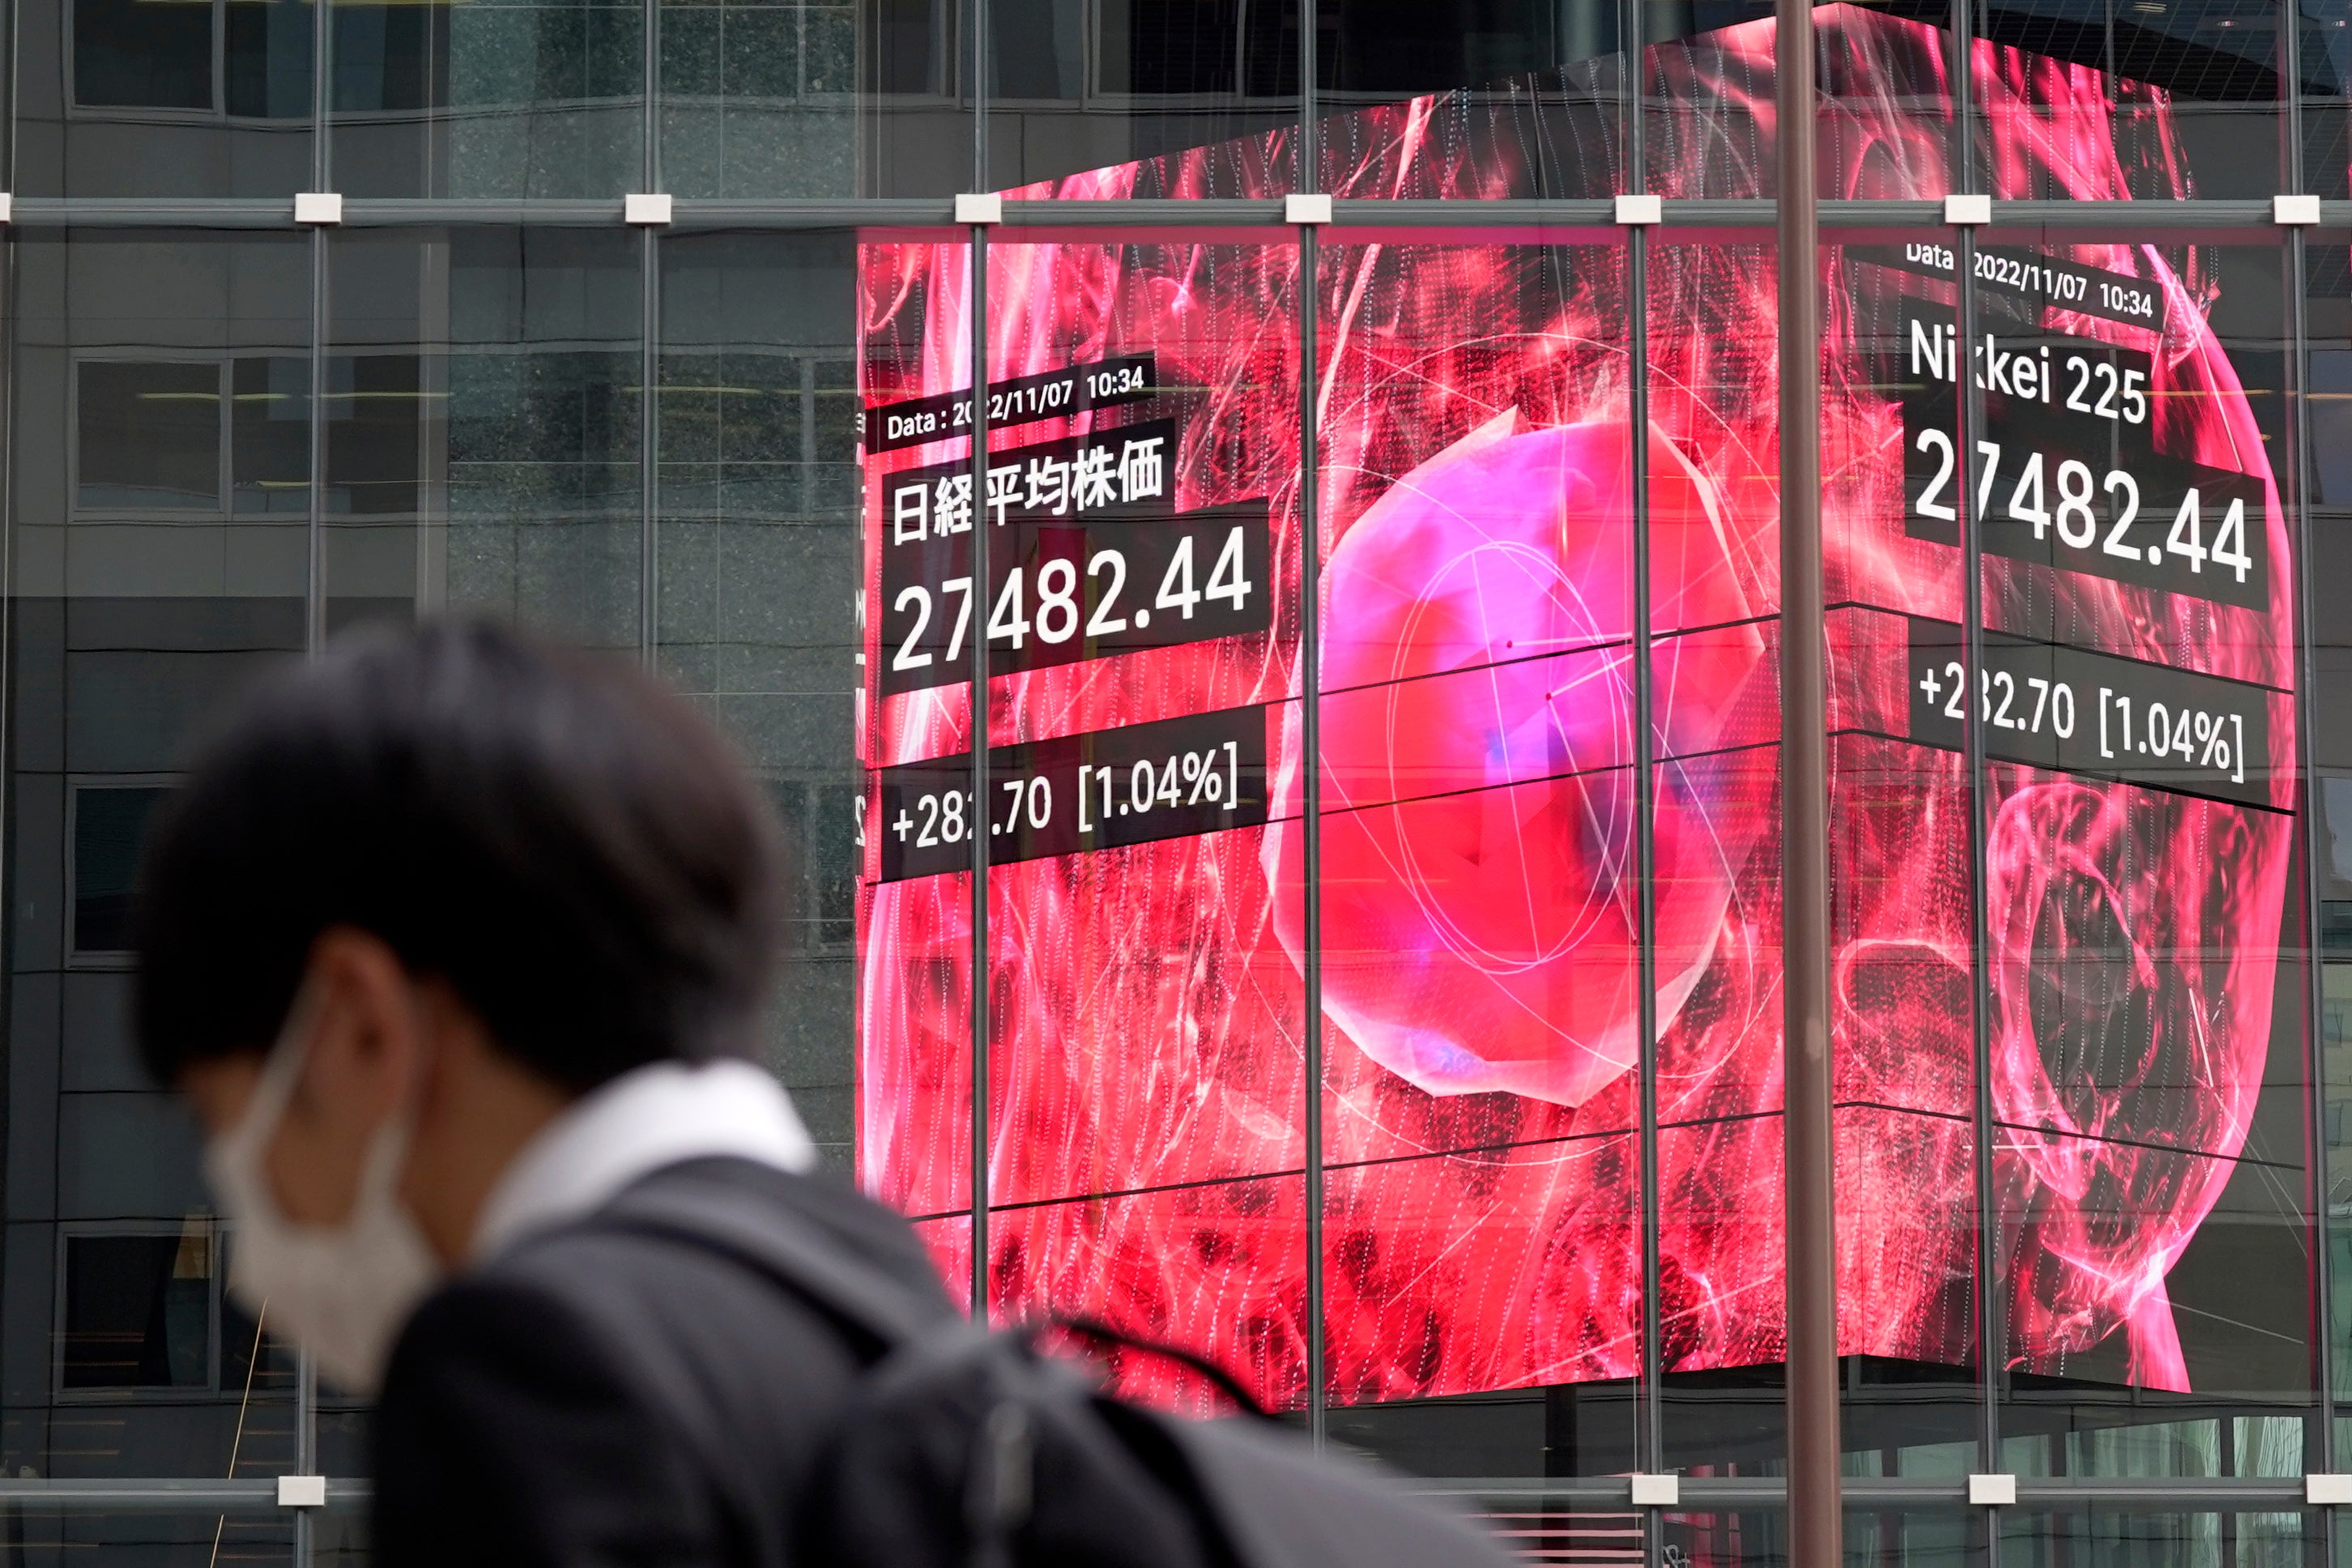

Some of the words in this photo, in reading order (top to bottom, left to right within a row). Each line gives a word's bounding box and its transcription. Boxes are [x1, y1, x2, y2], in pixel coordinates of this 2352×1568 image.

[1907, 243, 1954, 271] Data
[1974, 252, 2087, 301] 2022/11/07
[2099, 283, 2153, 317] 10:34
[888, 412, 935, 440] Data
[952, 381, 1073, 427] 202/11/07
[1087, 365, 1144, 398] 10:34
[1911, 319, 2050, 403] Nikei
[2066, 356, 2145, 424] 225
[893, 437, 1164, 546] 日経平均株価
[1915, 428, 2252, 583] 27482.44
[893, 526, 1252, 671] 27482.44
[2099, 687, 2244, 784] [1.04%]
[893, 776, 1051, 848] +28.70
[1079, 741, 1238, 833] [1.04%]
